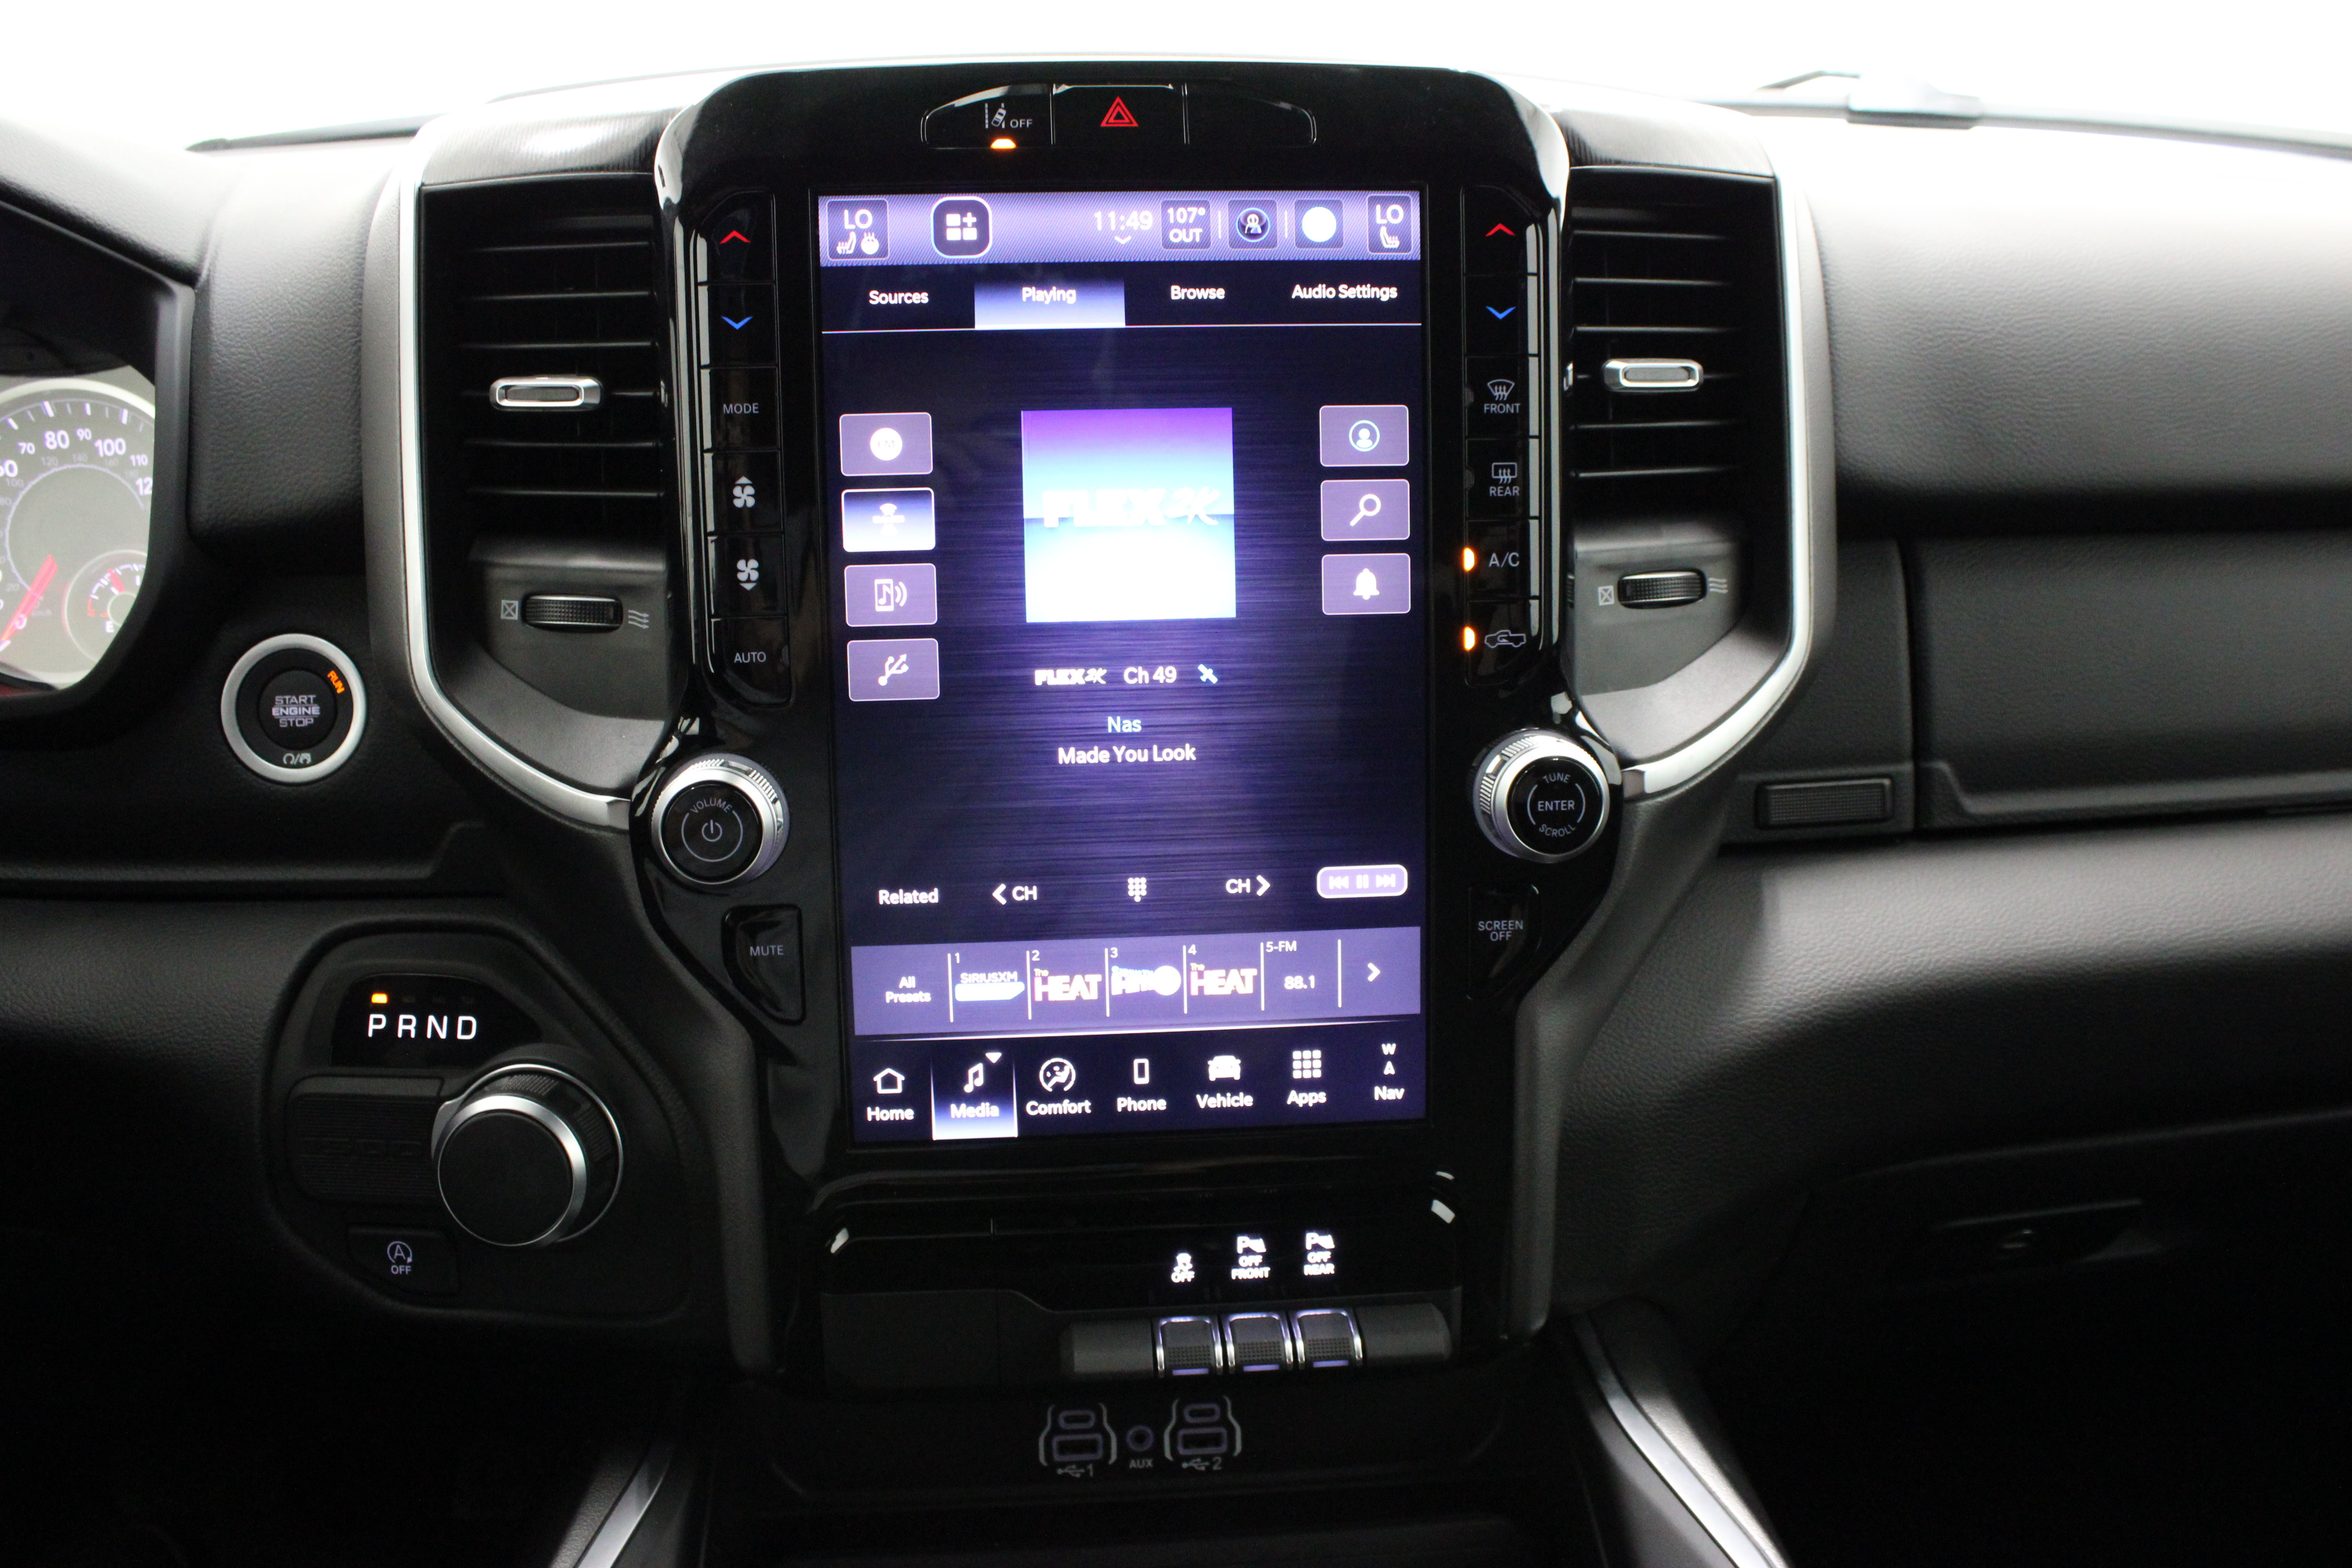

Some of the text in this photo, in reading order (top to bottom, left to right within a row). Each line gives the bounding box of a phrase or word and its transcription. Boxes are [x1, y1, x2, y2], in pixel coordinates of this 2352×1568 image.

[1010, 118, 1033, 129] OFF
[844, 209, 873, 229] LO
[1094, 209, 1153, 231] 11:49
[1375, 204, 1404, 225] LO
[1169, 227, 1203, 243] OUT
[869, 289, 929, 305] Sources
[1022, 286, 1077, 305] Playing
[1170, 284, 1226, 300] Browse
[1292, 283, 1398, 301] Audio Settings
[723, 403, 759, 414] MODE
[1484, 403, 1521, 414] FRONT
[44, 430, 70, 450] 80
[76, 428, 92, 441] 90
[18, 441, 36, 455] 70
[94, 437, 127, 457] 100
[129, 454, 148, 467] 110
[1489, 486, 1520, 497] REAR
[1489, 552, 1520, 568] A/C
[105, 620, 115, 633] E
[734, 652, 766, 663] AUTO
[1123, 666, 1149, 684] Ch
[1152, 666, 1177, 684] 49
[327, 670, 345, 694] RUN
[275, 695, 316, 705] START
[272, 706, 321, 716] ENGINE
[279, 717, 314, 727] STOP
[1107, 716, 1142, 733] Nas
[1058, 743, 1196, 764] Made You Look
[1543, 772, 1571, 784] TUNE
[690, 797, 733, 813] VOLUME
[1538, 800, 1575, 811] ENTER
[1539, 824, 1577, 837] SCROLL
[1225, 878, 1251, 894] CH
[878, 887, 939, 905] Related
[1011, 885, 1038, 901] CH
[1478, 920, 1524, 931] SCREEN
[1490, 931, 1512, 942] OFF
[750, 945, 785, 956] MUTE
[1110, 947, 1118, 958] 3
[1187, 944, 1197, 956] 4
[1265, 940, 1297, 953] 5-FM
[955, 952, 960, 964] 1
[1031, 950, 1040, 961] 2
[898, 976, 916, 989] All
[1034, 974, 1102, 1002] HEAT
[1189, 968, 1258, 996] HEAT
[1284, 975, 1316, 990] 88.1
[885, 990, 932, 1003] Presets
[1381, 1042, 1396, 1055] W
[1286, 1089, 1327, 1107] Apps
[1374, 1085, 1405, 1101] Nav
[1117, 1096, 1167, 1112] Phone
[1196, 1091, 1254, 1109] Vehicle
[866, 1106, 915, 1122] Home
[950, 1102, 1000, 1118] Media
[1025, 1099, 1091, 1116] Comfort
[1238, 1255, 1263, 1267] OFF
[1307, 1251, 1332, 1263] OFF
[391, 1265, 412, 1275] OFF
[1231, 1267, 1271, 1280] FRONT
[1304, 1263, 1335, 1276] REAR
[1171, 1271, 1195, 1283] OFF
[1129, 1459, 1153, 1469] AUX
[1213, 1457, 1222, 1470] 2
